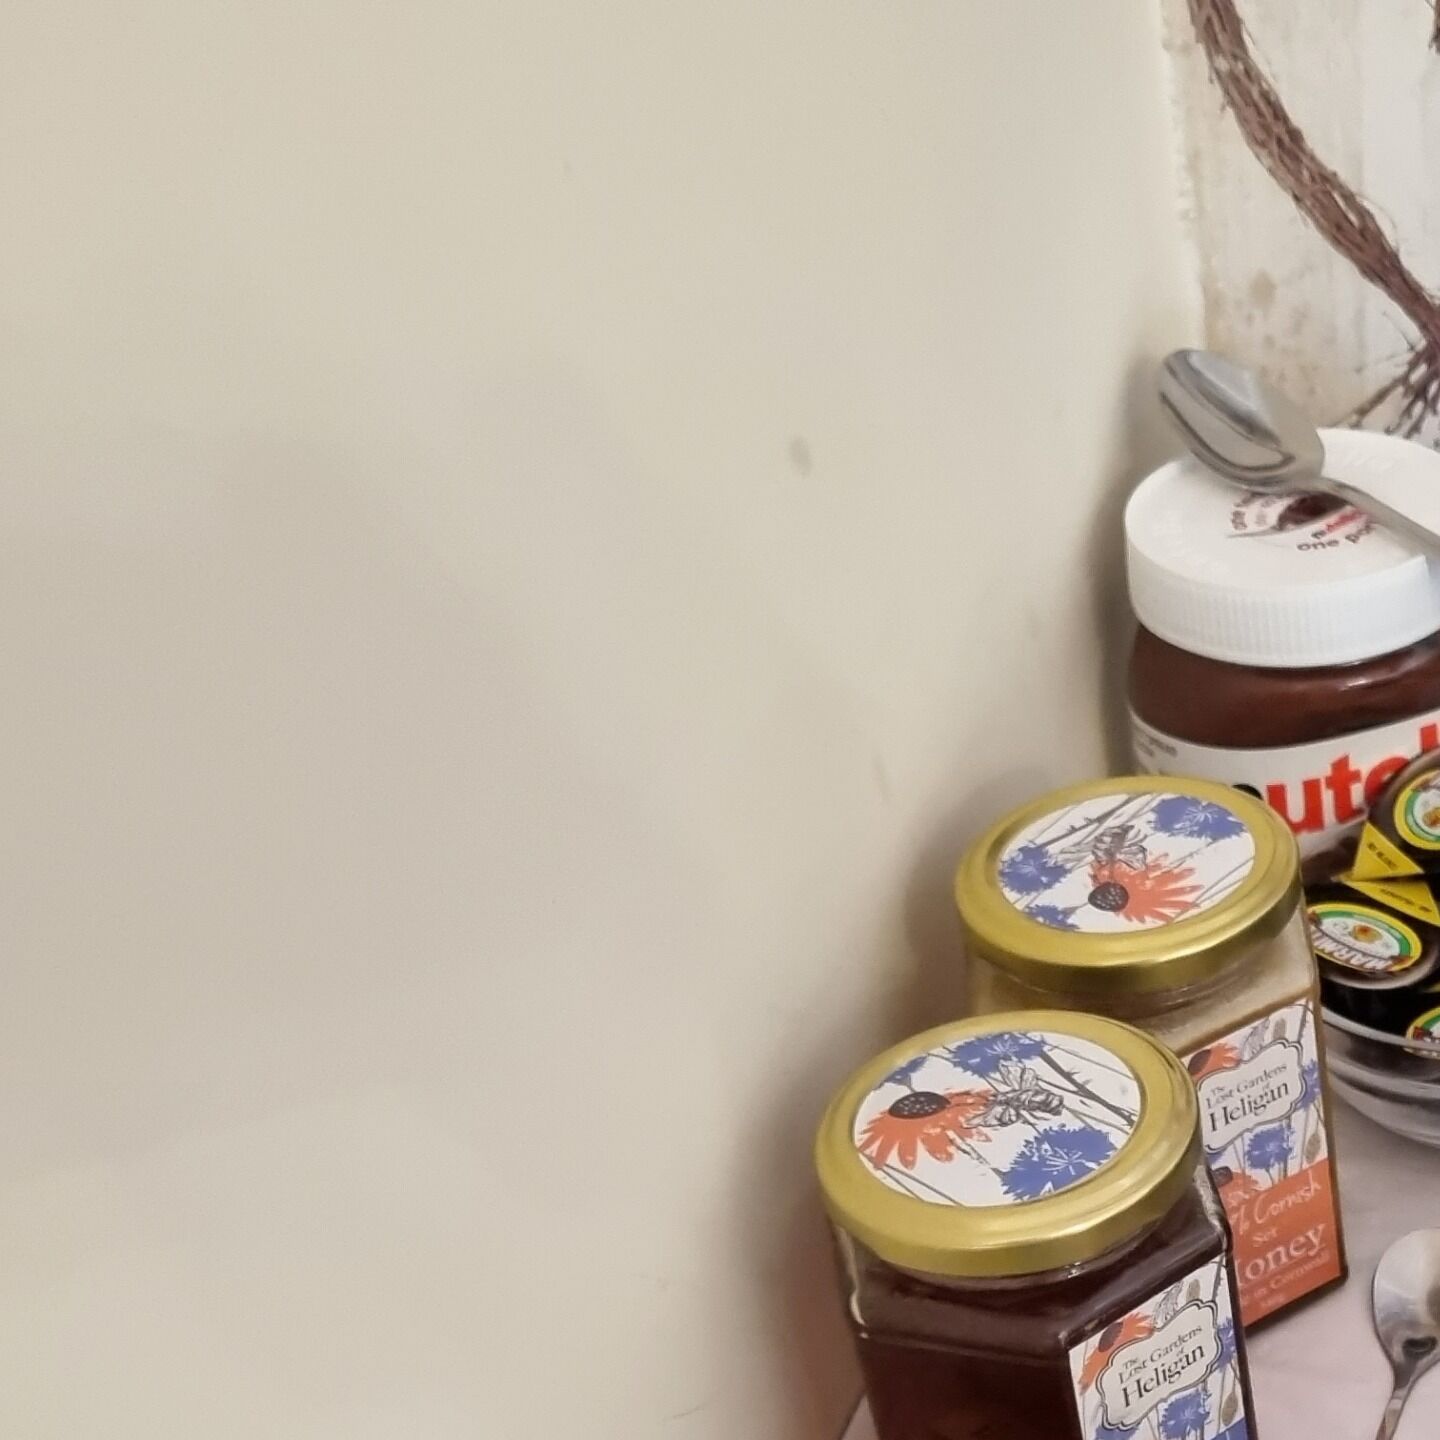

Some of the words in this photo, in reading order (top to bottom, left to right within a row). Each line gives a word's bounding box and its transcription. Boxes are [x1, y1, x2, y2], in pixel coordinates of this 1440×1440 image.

[1205, 1088, 1235, 1109] Lost
[1237, 1063, 1288, 1095] Gardens
[1208, 1081, 1290, 1133] Heligan
[1253, 1169, 1322, 1225] Cornish
[1118, 1360, 1147, 1385] Lost
[1150, 1326, 1204, 1363] Gardens
[1121, 1345, 1205, 1409] Heligan
